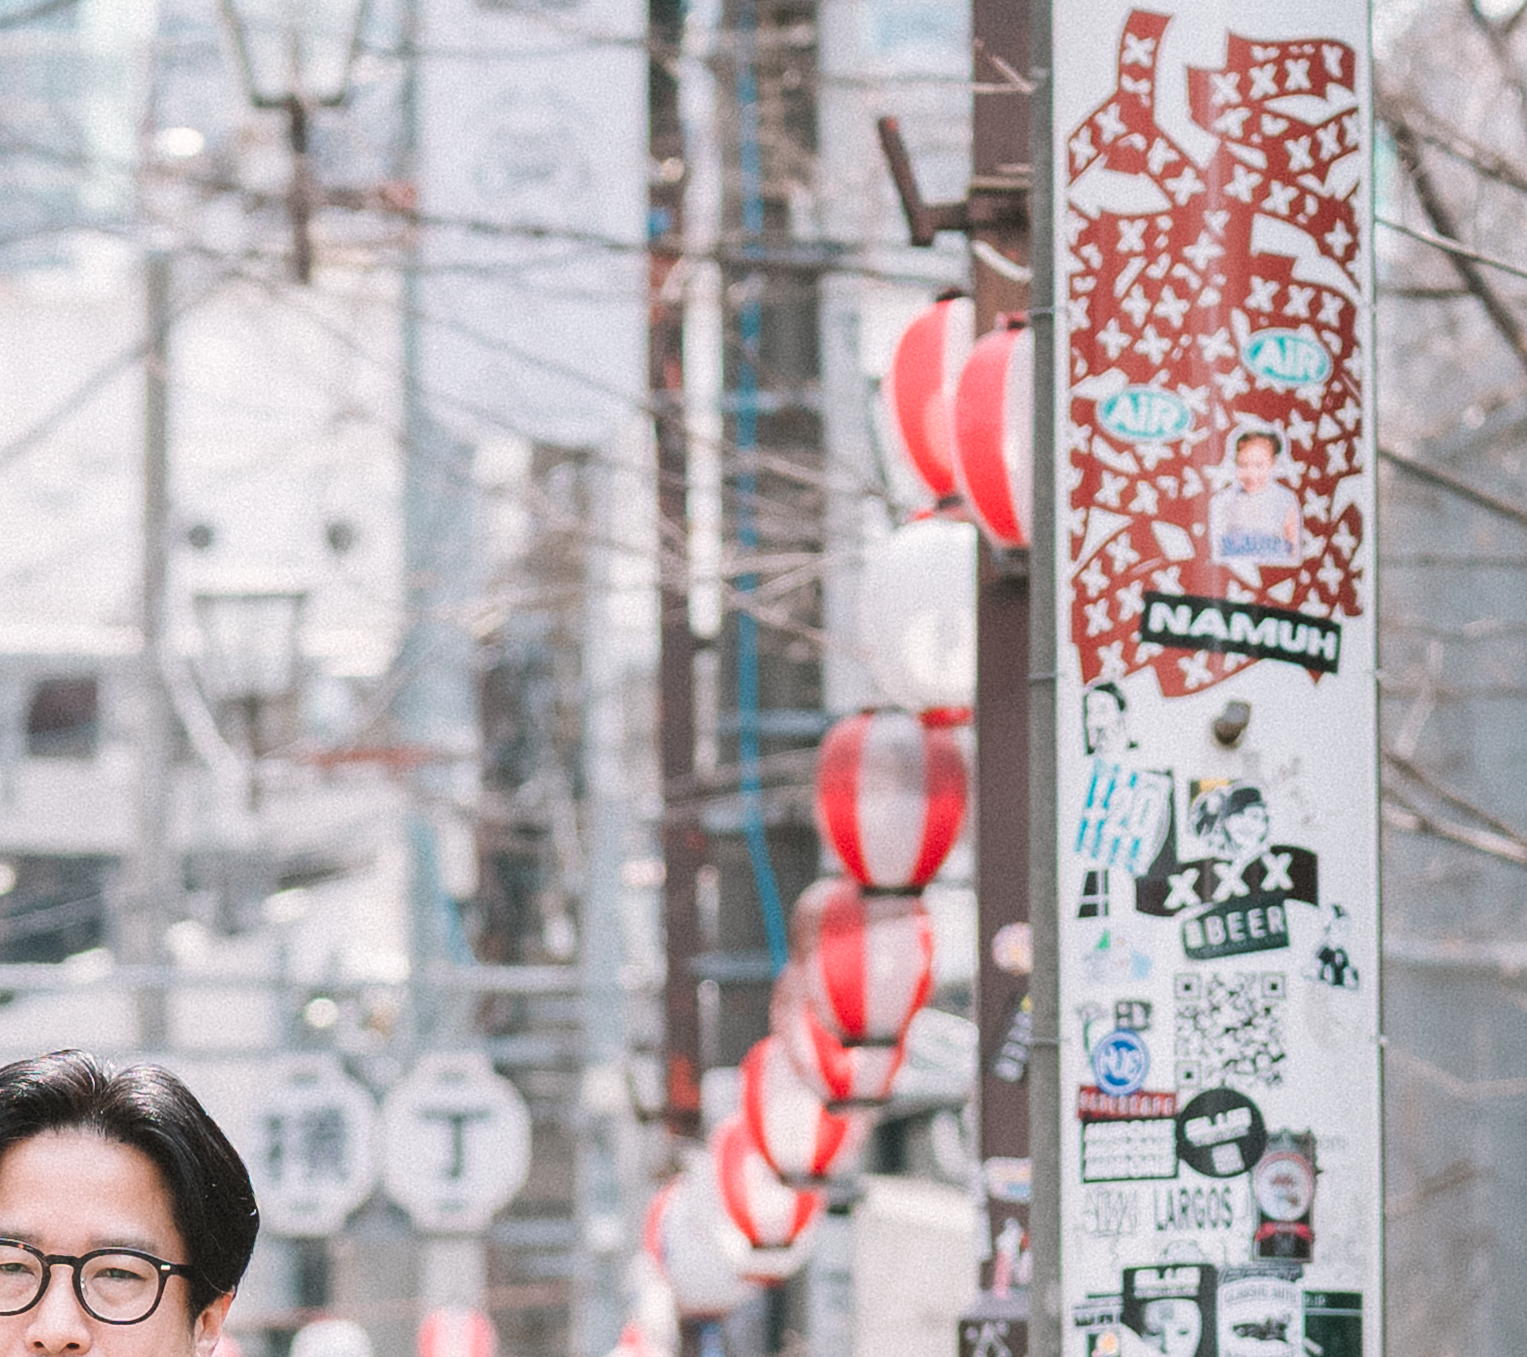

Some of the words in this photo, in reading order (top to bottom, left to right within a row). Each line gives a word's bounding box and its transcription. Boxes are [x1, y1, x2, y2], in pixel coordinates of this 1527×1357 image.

[1248, 338, 1323, 378] AIR
[1100, 393, 1185, 435] AIR
[1146, 600, 1341, 662] NAMUH
[1153, 1186, 1235, 1233] LARGOS
